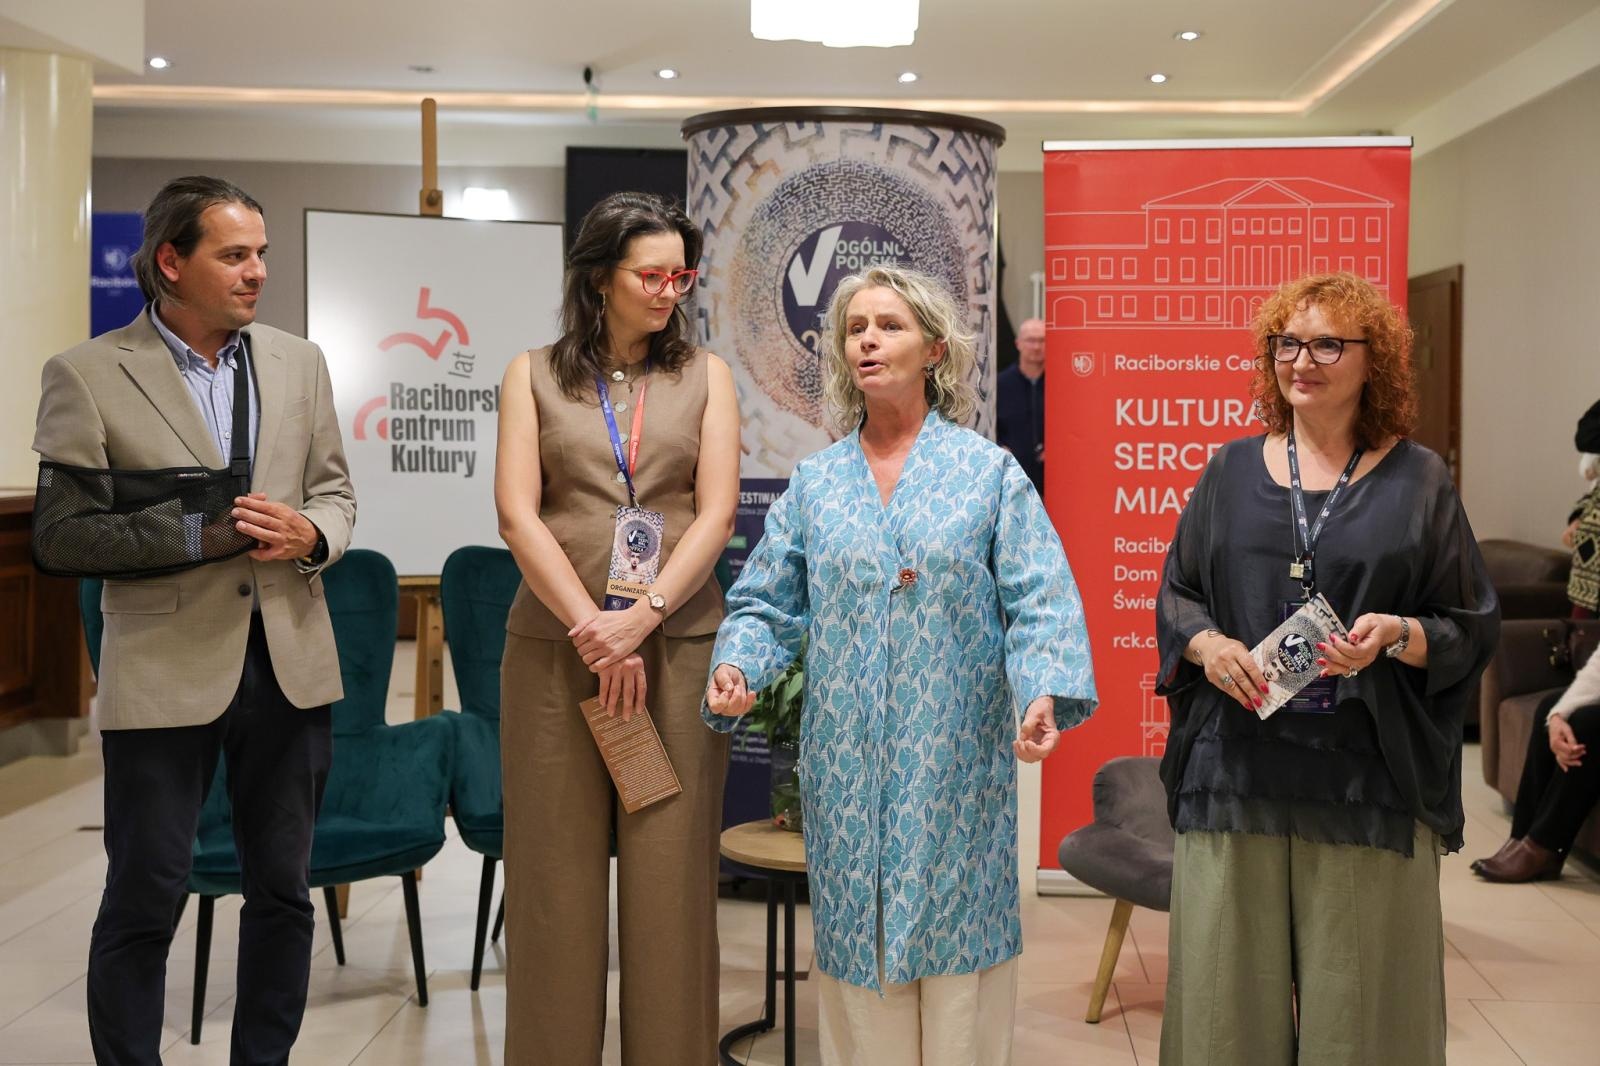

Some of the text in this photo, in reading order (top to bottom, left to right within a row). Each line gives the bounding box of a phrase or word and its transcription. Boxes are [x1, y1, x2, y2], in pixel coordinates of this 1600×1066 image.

[447, 351, 476, 379] lat
[1114, 354, 1221, 371] Raciborskie
[1115, 398, 1269, 426] KULTURA
[391, 444, 477, 478] Kultury
[1114, 564, 1158, 582] Dom
[1113, 631, 1158, 648] rck.c
